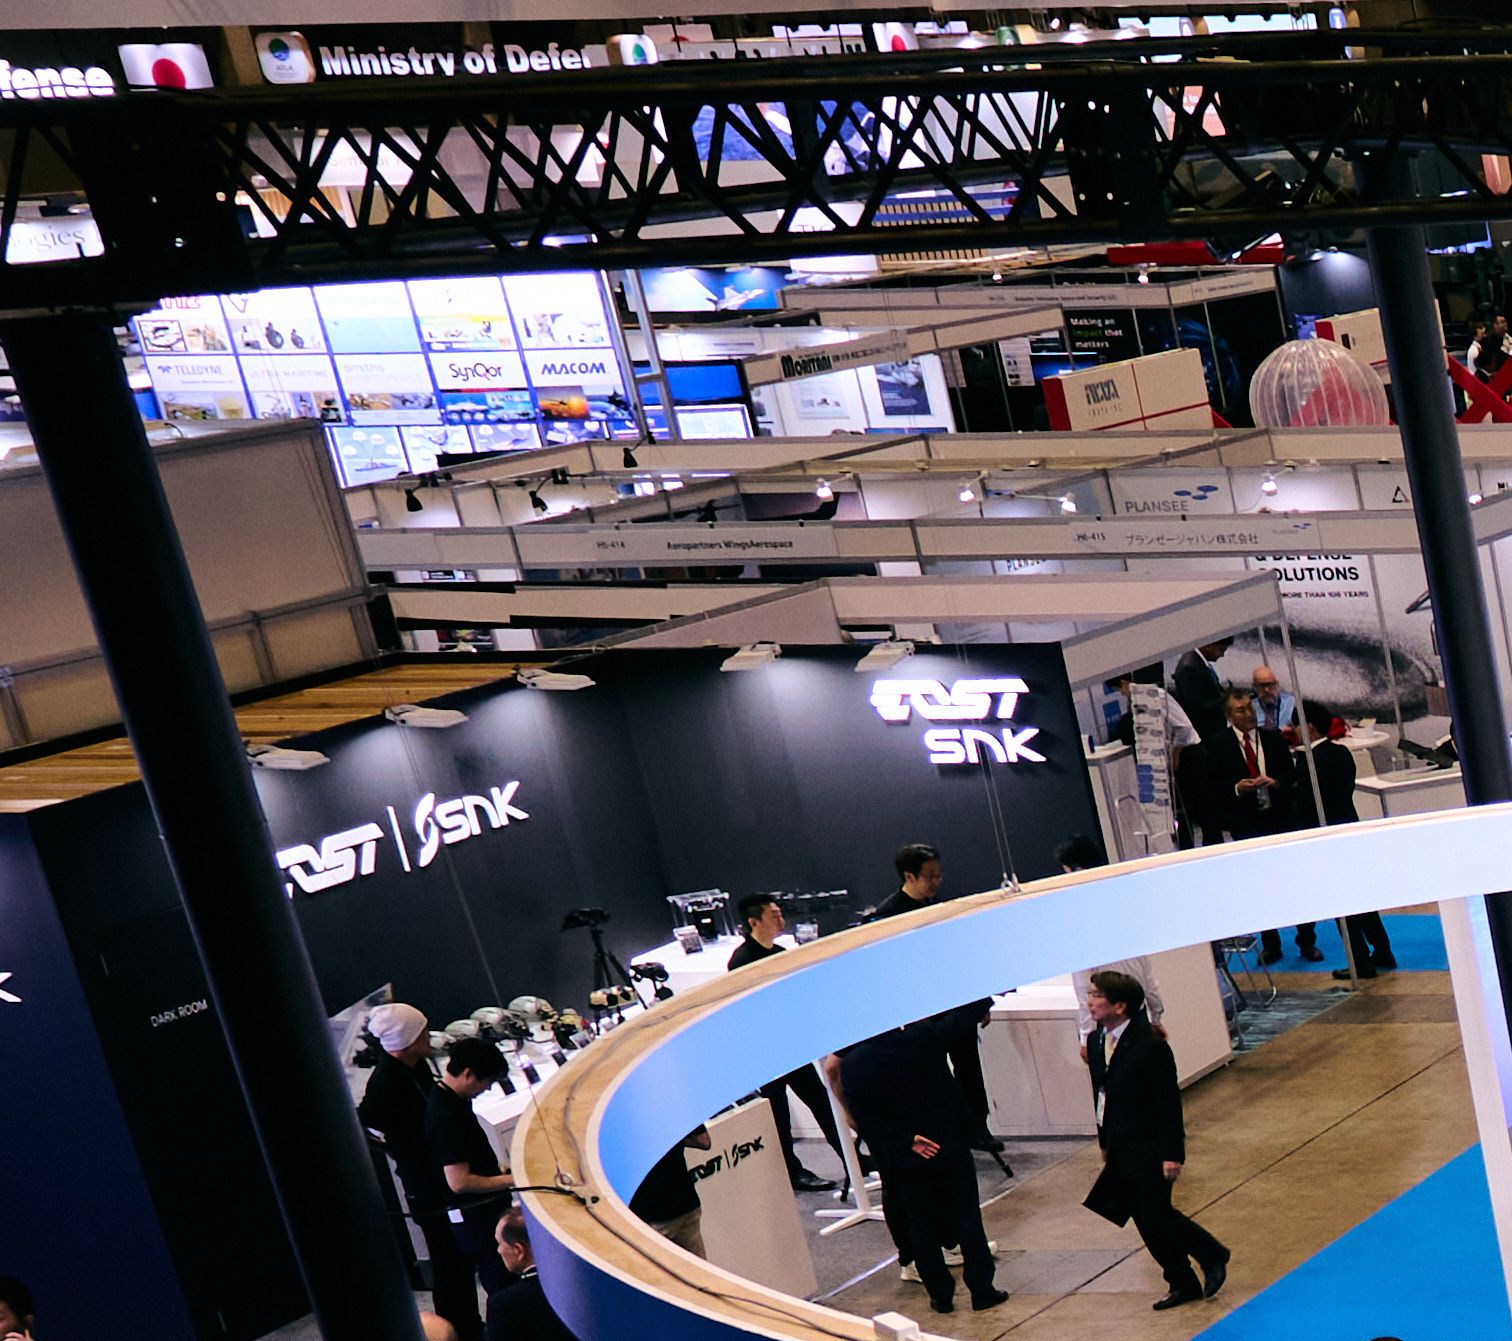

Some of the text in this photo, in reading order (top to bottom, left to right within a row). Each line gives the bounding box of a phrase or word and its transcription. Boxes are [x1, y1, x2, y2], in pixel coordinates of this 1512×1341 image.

[319, 45, 455, 77] Ministry
[463, 43, 498, 74] of
[450, 362, 503, 382] SynQor
[541, 362, 606, 376] MACOM
[1124, 500, 1190, 514] PLANSEE
[1260, 567, 1360, 582] OLUTIONS
[923, 728, 1048, 764] SNK
[431, 780, 530, 845] SNK
[151, 999, 209, 1028] DARK ROOM
